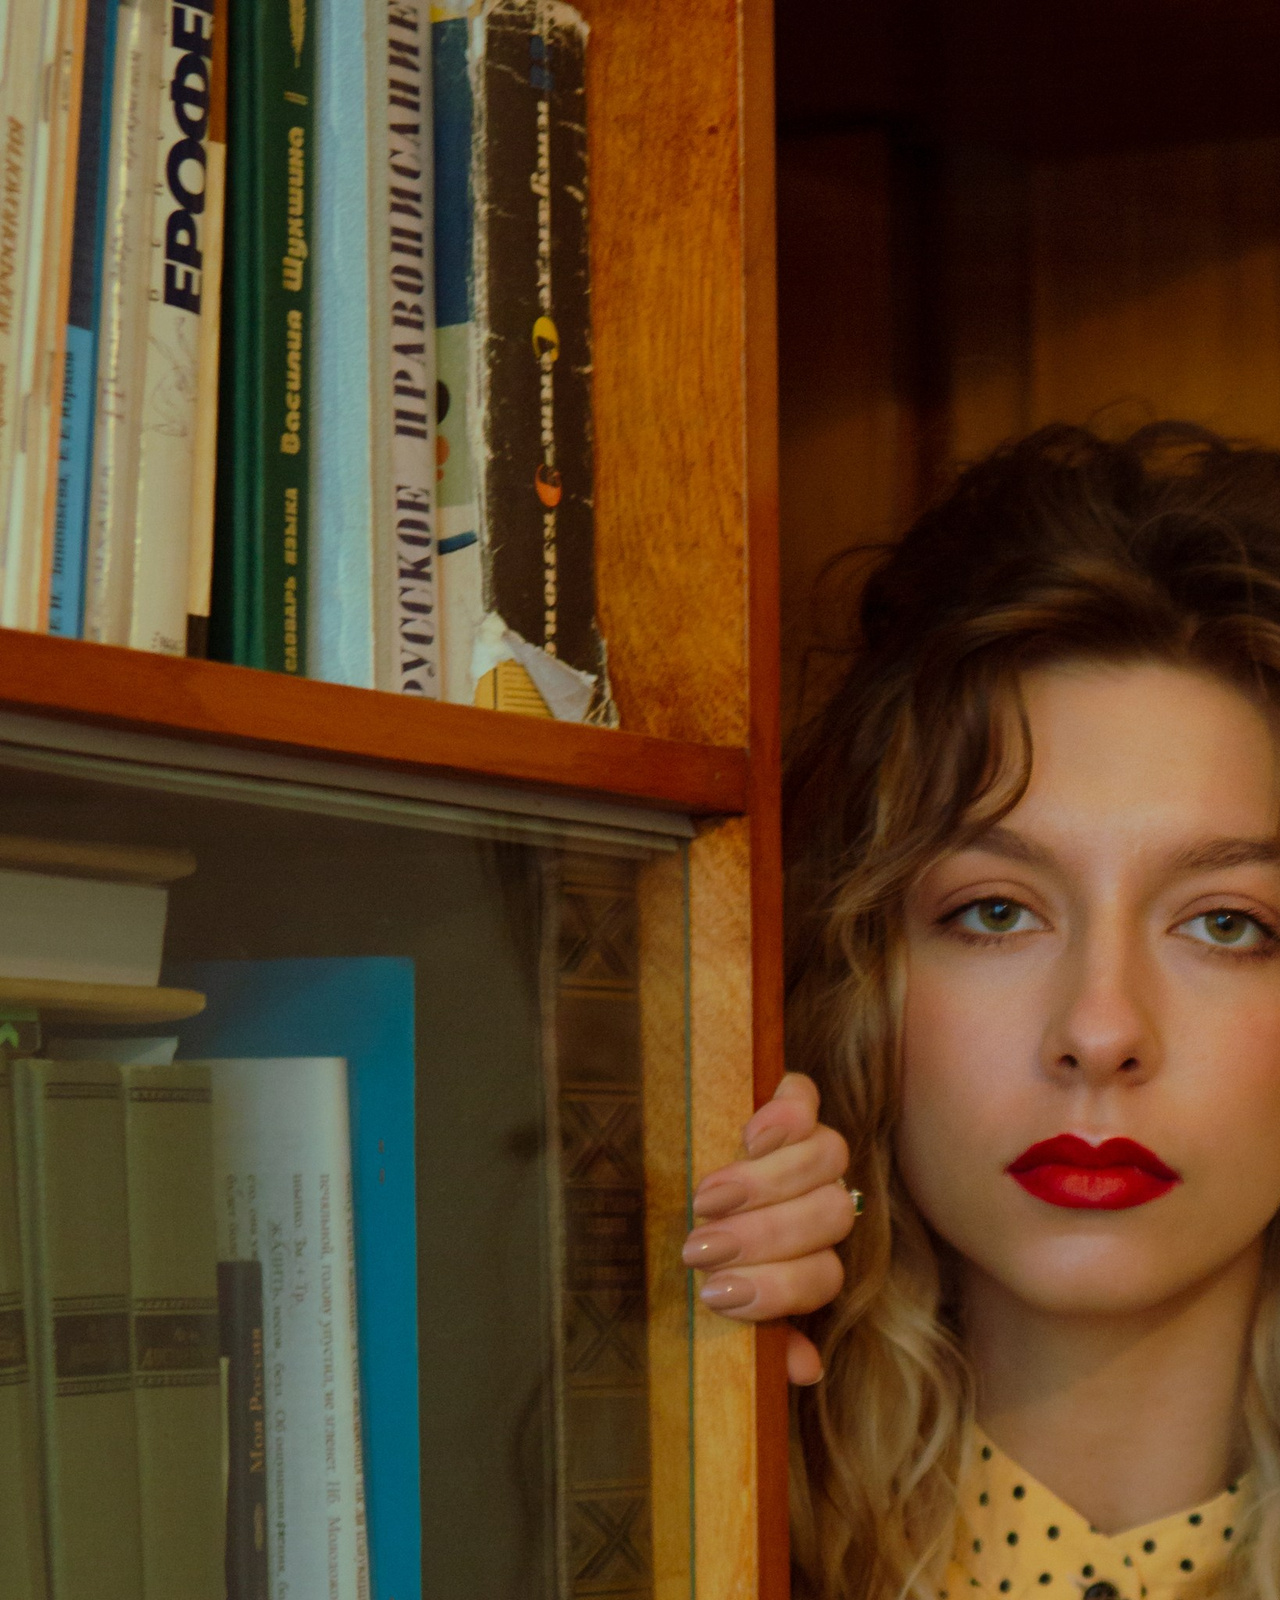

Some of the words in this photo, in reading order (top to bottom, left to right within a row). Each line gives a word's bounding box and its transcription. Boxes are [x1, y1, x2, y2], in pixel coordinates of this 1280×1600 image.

[163, 0, 214, 316] ЕРОФЕ
[282, 127, 309, 292] Шукшина
[387, 0, 429, 441] ПРАВОПИСАНИЕ
[279, 310, 304, 454] Василия
[284, 486, 299, 567] ЯЗЫКА
[284, 577, 299, 672] СЛОВАРЬ
[248, 1327, 264, 1412] Россия
